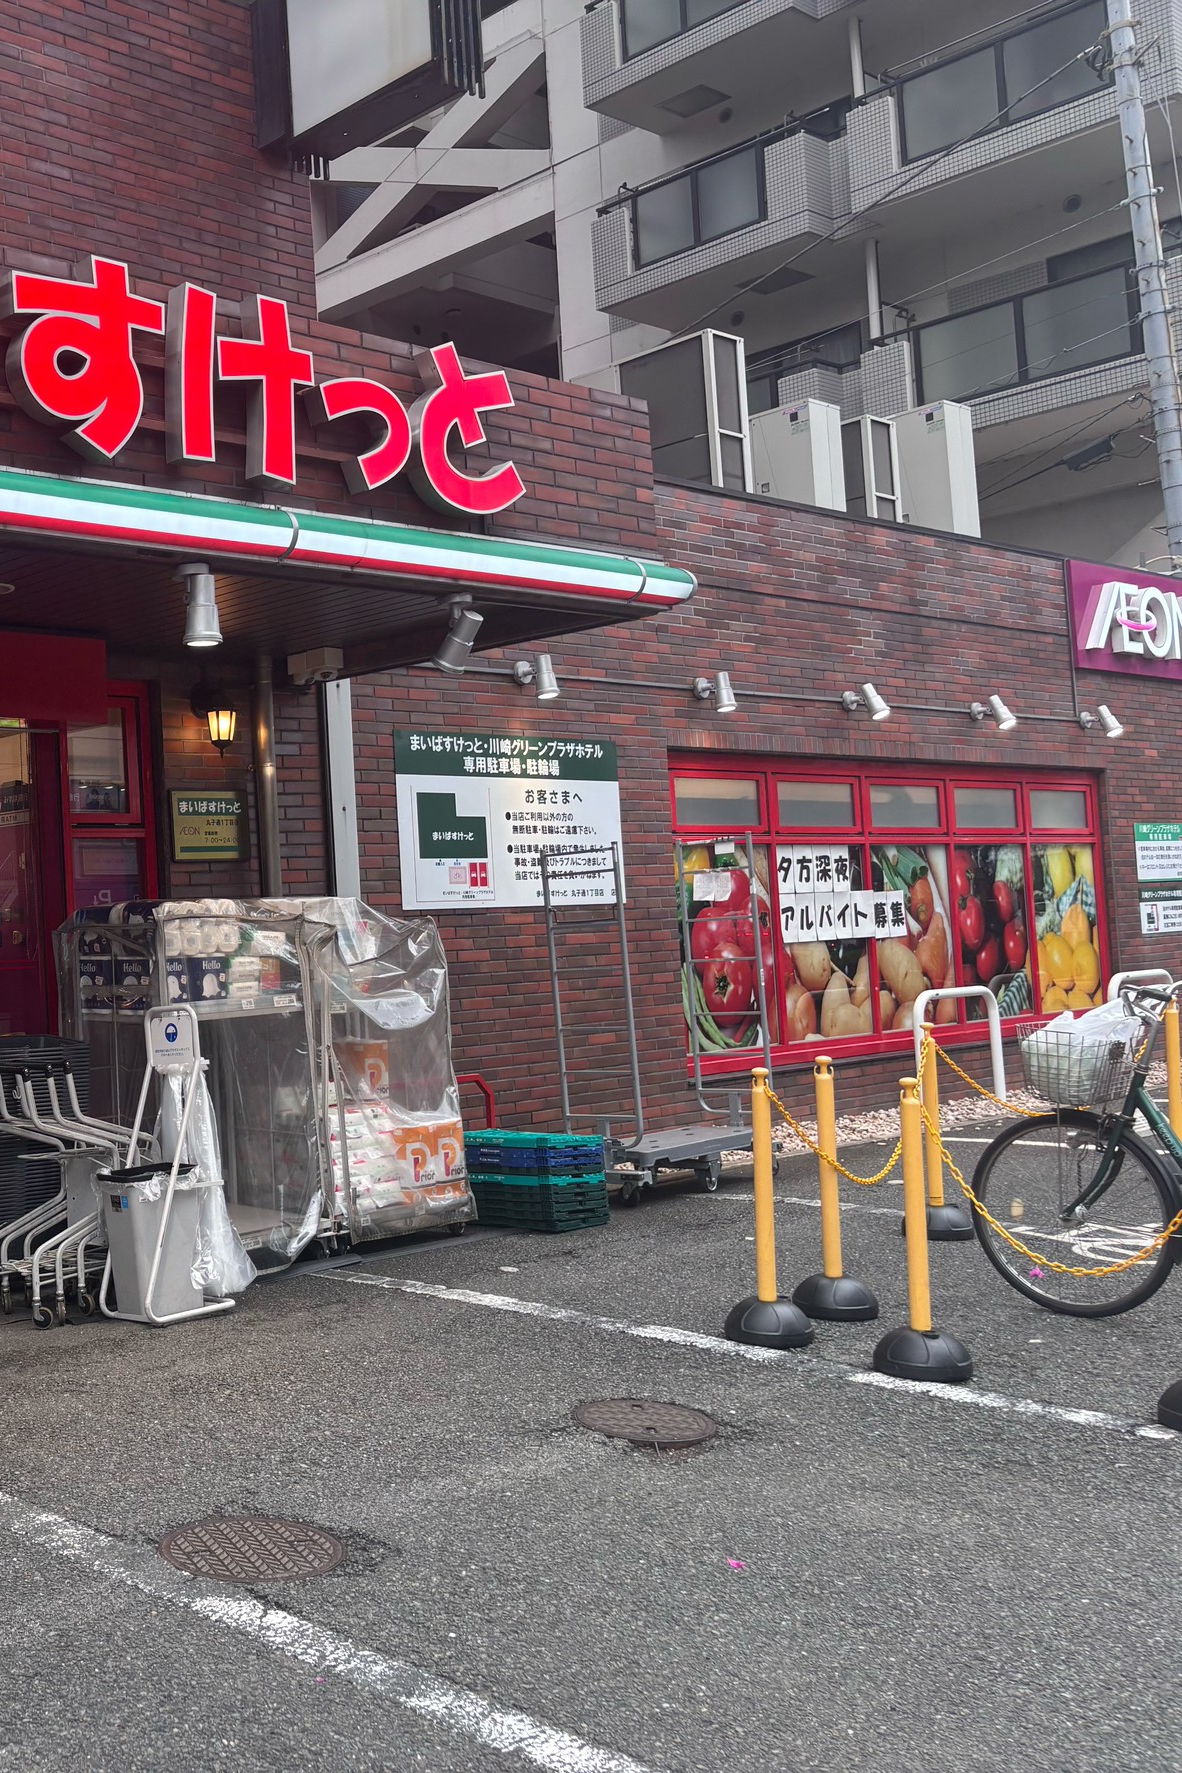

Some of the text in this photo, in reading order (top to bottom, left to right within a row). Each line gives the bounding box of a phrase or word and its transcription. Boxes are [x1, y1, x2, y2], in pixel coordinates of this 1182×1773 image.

[409, 734, 604, 759] まいばすけっと・川崎グリーンプラザホテル
[463, 756, 561, 777] 専用駐車場・駐輪場
[524, 788, 583, 805] お客さまへ
[179, 801, 242, 813] まいばすけっと
[179, 826, 201, 836] AEON
[432, 831, 475, 841] まいばすけっと
[778, 855, 849, 883] 夕方深夜
[781, 901, 905, 932] アルバイト募集
[123, 962, 142, 973] Hello
[202, 960, 221, 970] Hello
